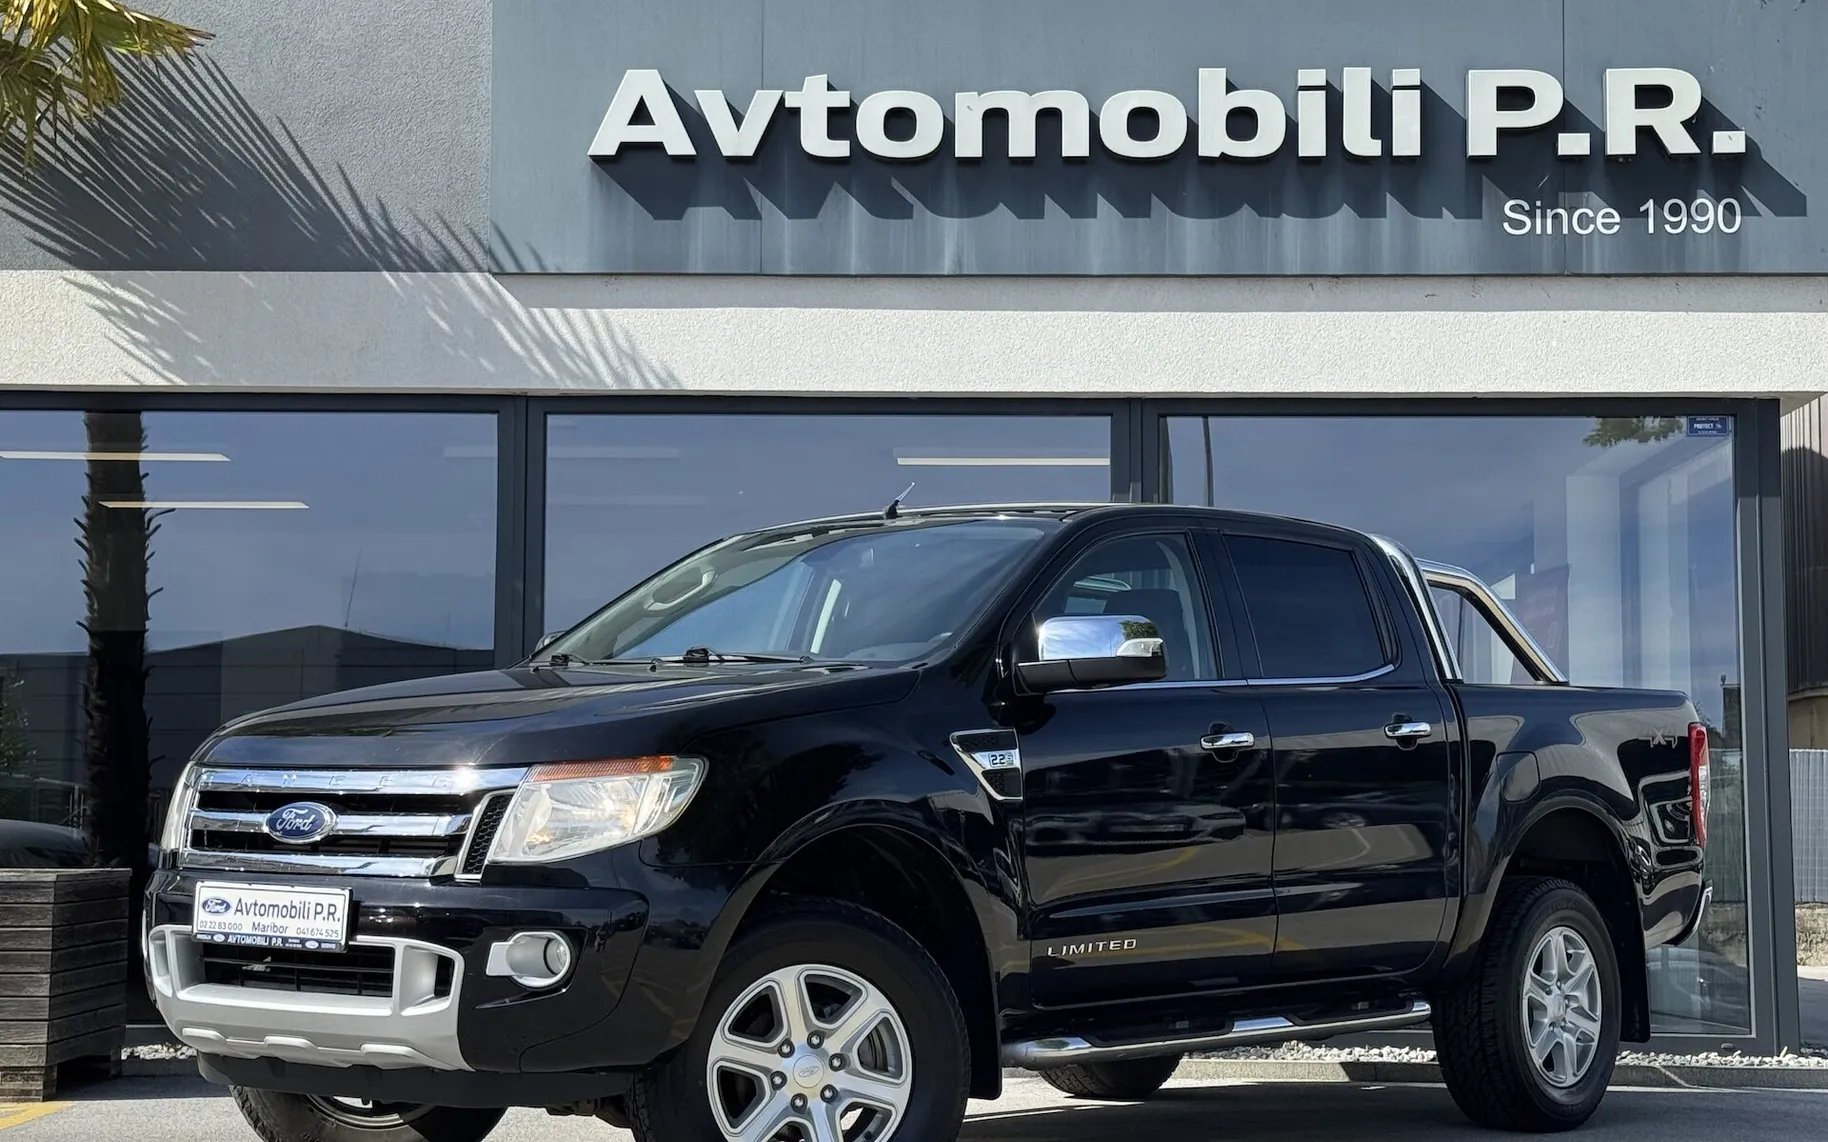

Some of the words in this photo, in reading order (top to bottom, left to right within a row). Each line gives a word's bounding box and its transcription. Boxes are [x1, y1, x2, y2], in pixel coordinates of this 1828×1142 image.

[587, 66, 1421, 158] Avtomobili
[1465, 67, 1747, 157] P.R.
[1502, 198, 1621, 236] Since
[1639, 198, 1742, 235] 1990
[276, 808, 316, 831] Ford
[204, 899, 227, 913] Ford
[234, 897, 311, 920] Avtomobili
[313, 902, 341, 922] P.R.
[251, 921, 289, 934] Maribor
[227, 934, 269, 946] AVTOMOBILI
[1047, 939, 1137, 957] LIMITED
